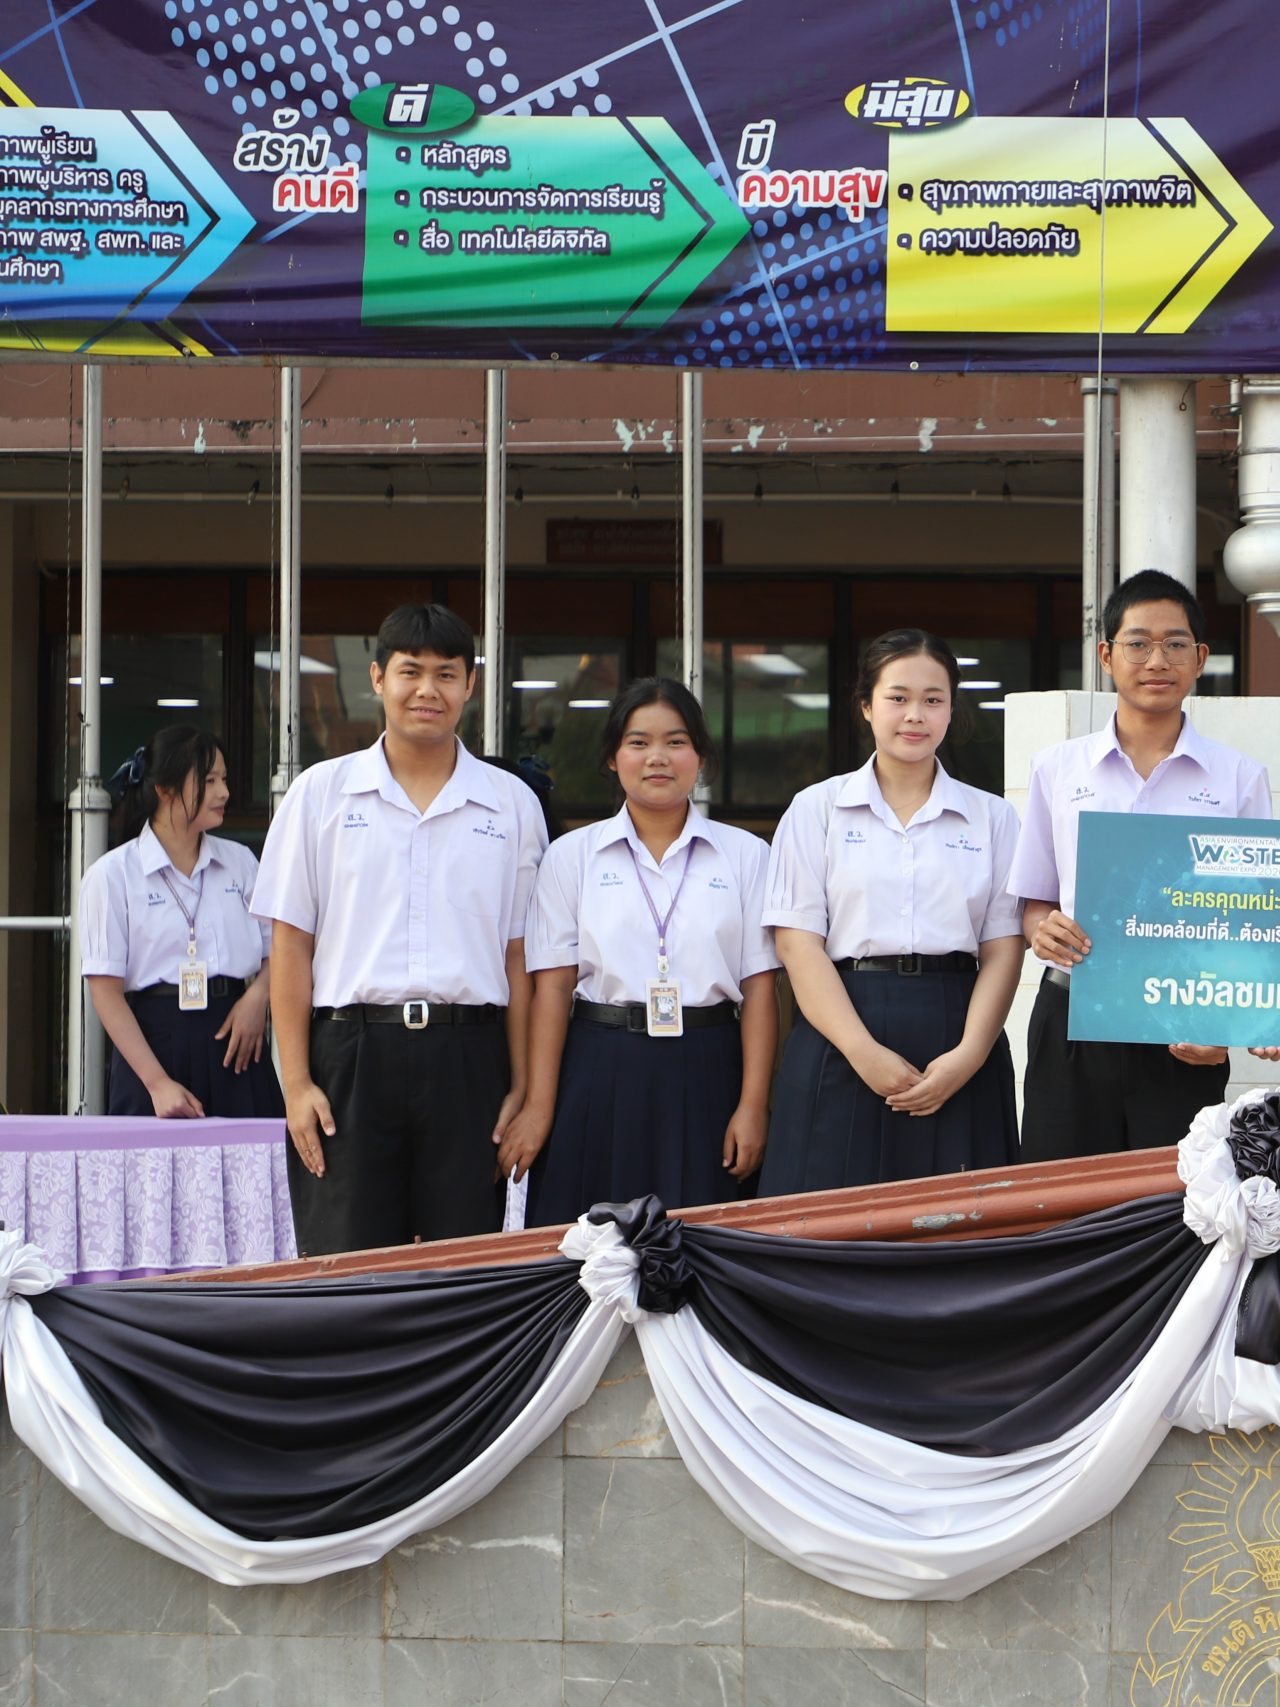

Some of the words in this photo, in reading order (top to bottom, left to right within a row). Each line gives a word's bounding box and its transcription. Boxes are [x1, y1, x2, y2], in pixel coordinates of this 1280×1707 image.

[388, 83, 430, 123] ดี
[863, 79, 955, 126] มีสุข
[236, 111, 329, 169] สร้าง
[422, 143, 507, 170] หลักสูตร
[276, 165, 357, 210] คนดี
[421, 181, 662, 214] กระบวนการจัดการเรียนรู้
[740, 170, 886, 220] ความสุข
[151, 233, 182, 250] และ
[421, 221, 450, 250] สื่อ
[460, 227, 608, 250] เทคโนโลยีดิจิทัล
[920, 226, 1077, 251] ความปลอดภัย
[1216, 837, 1277, 847] ENVIRONMENTAL
[1196, 864, 1239, 873] MANAGEMENT
